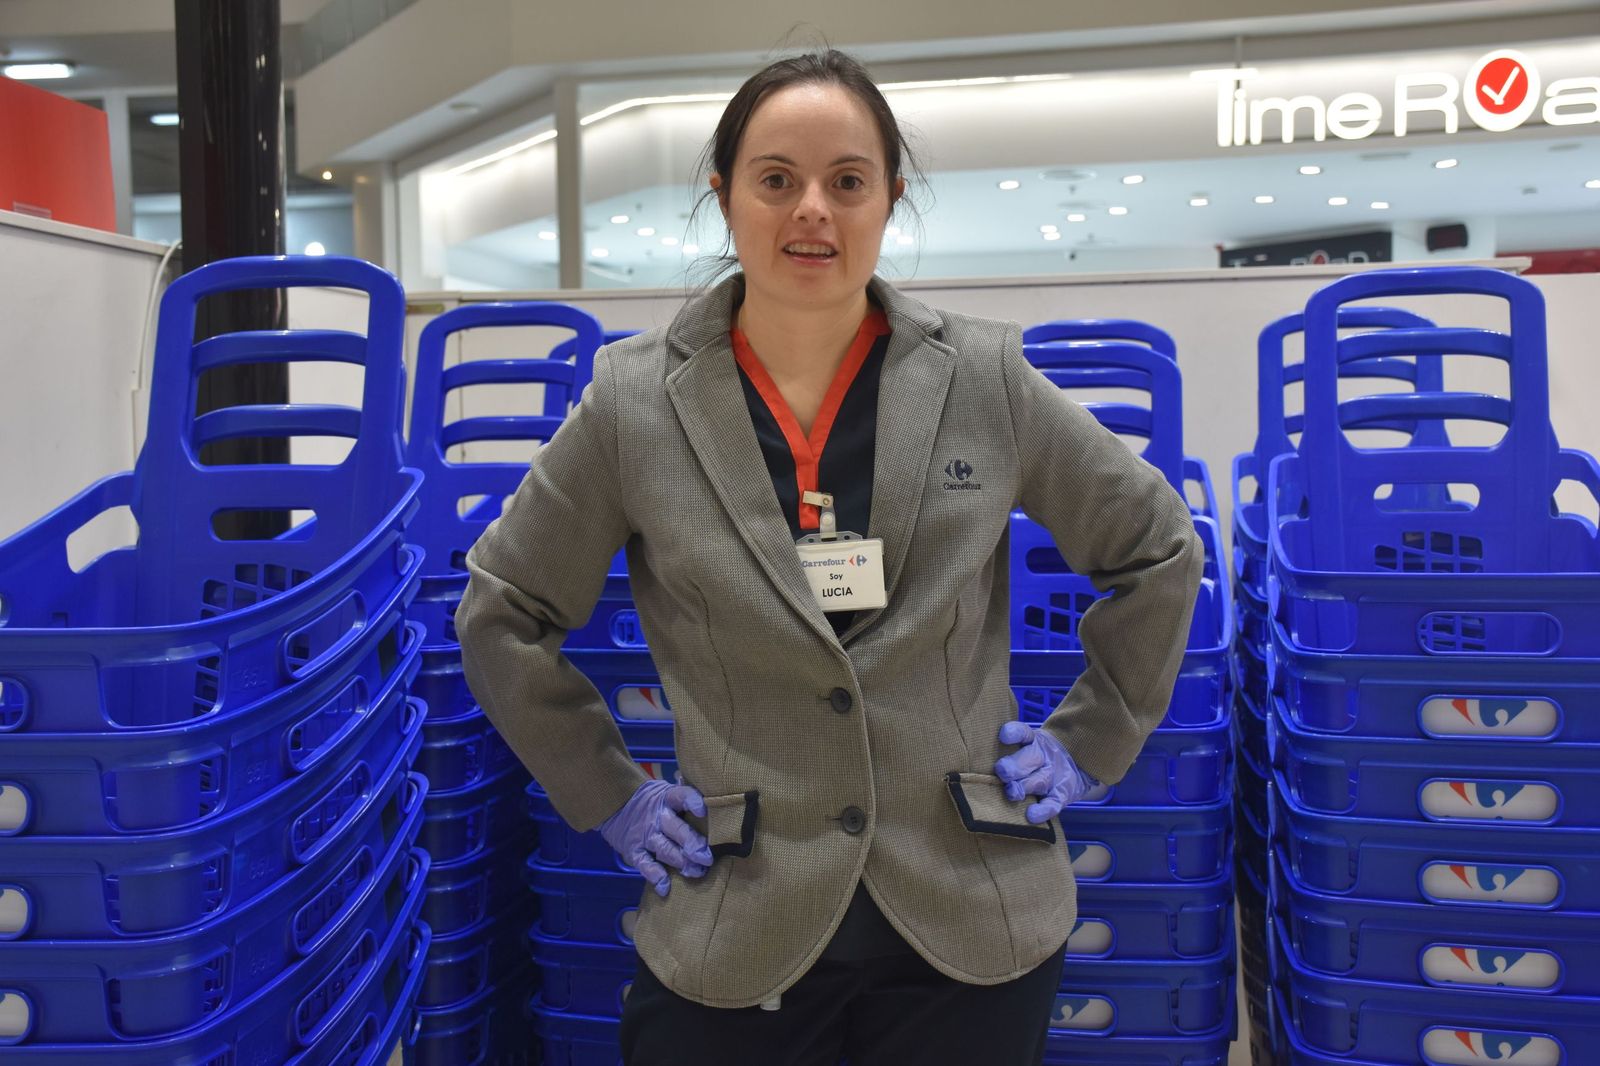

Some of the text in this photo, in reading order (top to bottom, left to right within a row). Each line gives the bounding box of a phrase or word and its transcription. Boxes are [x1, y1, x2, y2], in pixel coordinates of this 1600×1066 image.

[1189, 68, 1383, 148] Time
[943, 481, 981, 490] Carrefour
[801, 558, 846, 568] Carrefour
[822, 586, 853, 598] LUCIA
